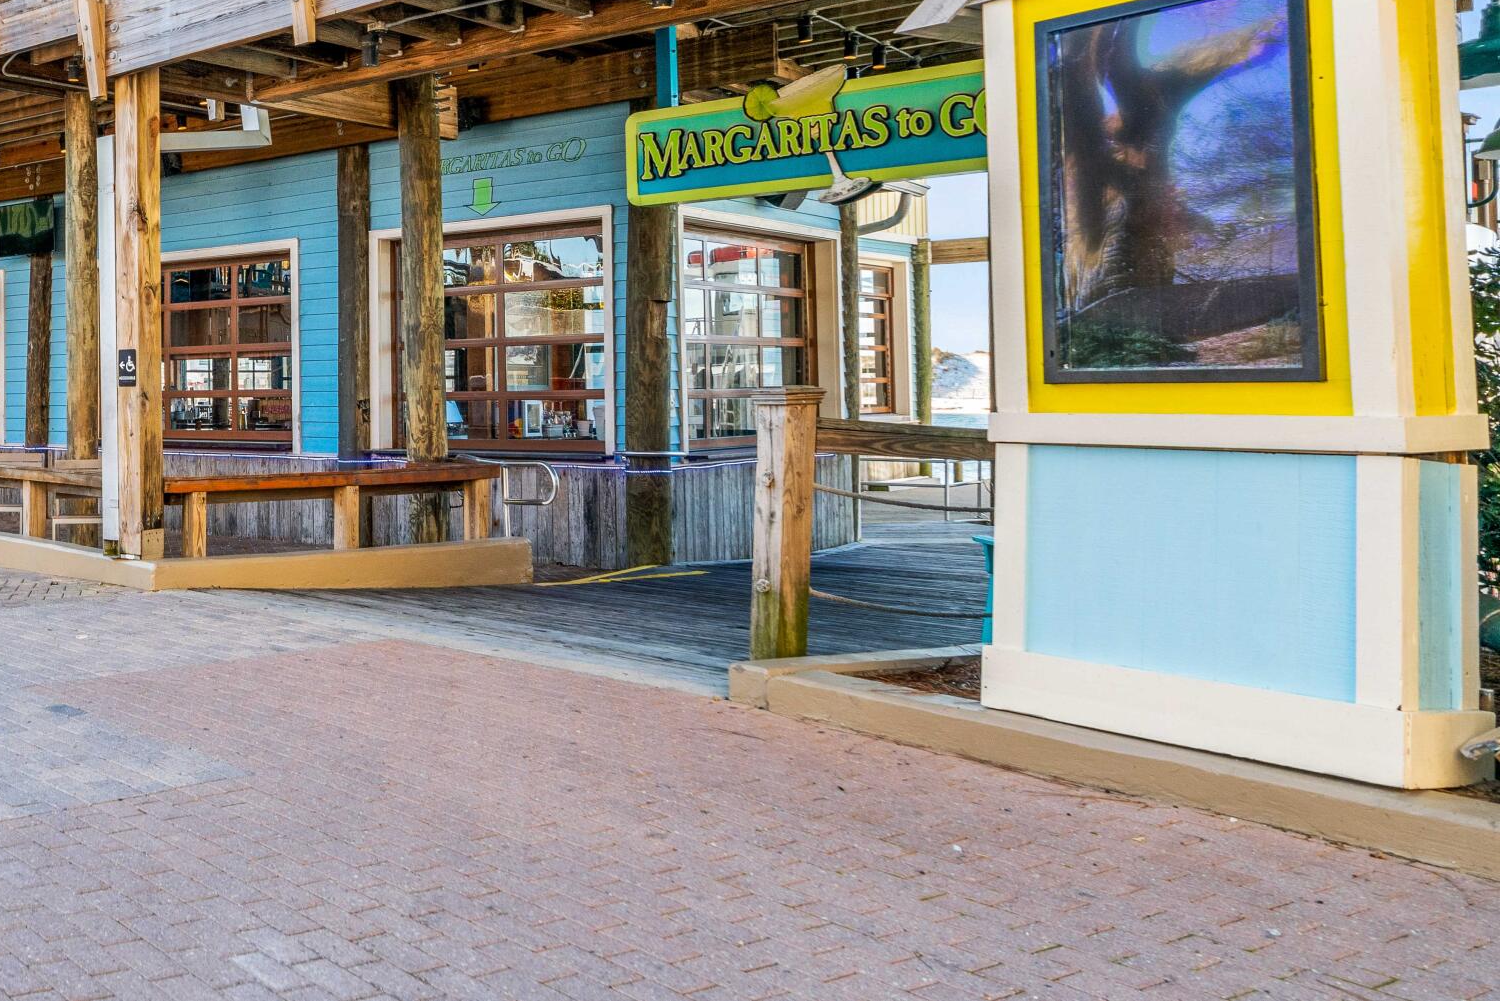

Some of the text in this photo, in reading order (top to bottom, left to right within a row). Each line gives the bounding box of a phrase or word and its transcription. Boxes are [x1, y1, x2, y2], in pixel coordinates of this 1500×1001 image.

[440, 136, 587, 176] RGARITAS to GO
[640, 105, 890, 181] MARGARITAS
[896, 108, 933, 137] to
